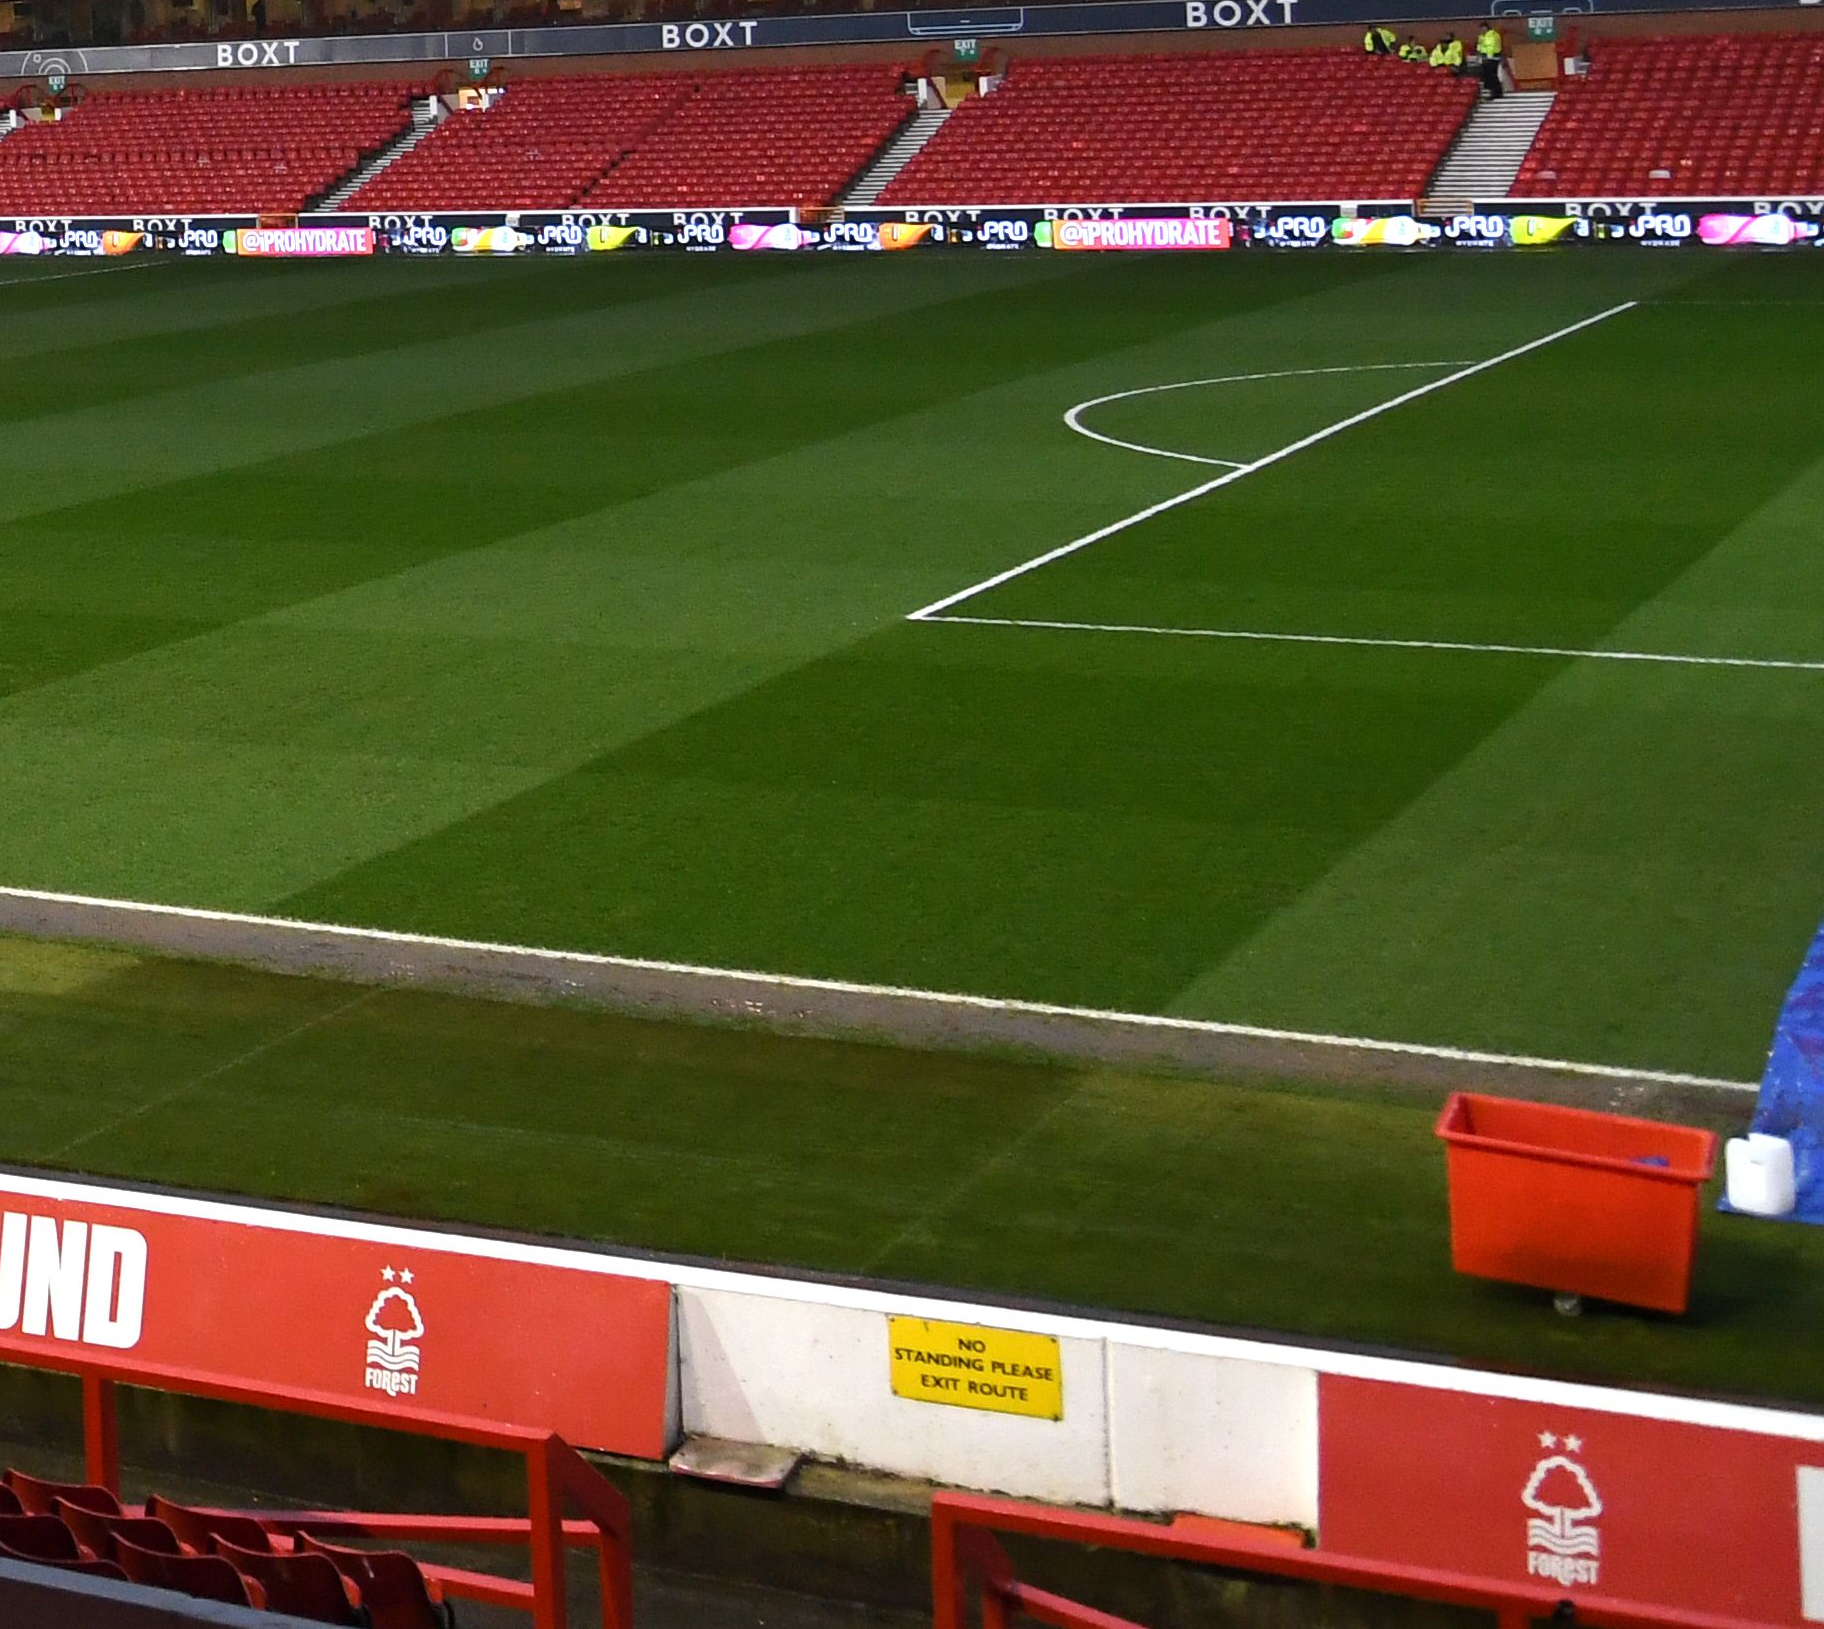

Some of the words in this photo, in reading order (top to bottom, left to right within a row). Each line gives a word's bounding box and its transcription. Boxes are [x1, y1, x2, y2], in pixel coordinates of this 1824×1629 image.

[1529, 16, 1554, 28] EXIT
[661, 21, 758, 48] BOXT
[955, 39, 977, 50] EXIT
[217, 42, 300, 67] BOXT
[469, 59, 488, 69] EXIT
[243, 229, 366, 254] @iPROHYDRATE
[1060, 222, 1221, 246] @iPROHYDRATE
[958, 1337, 986, 1353] NO
[894, 1348, 984, 1372] STANDING
[991, 1360, 1054, 1381] PLEASE
[921, 1374, 960, 1391] EXIT
[968, 1380, 1028, 1402] ROUTE
